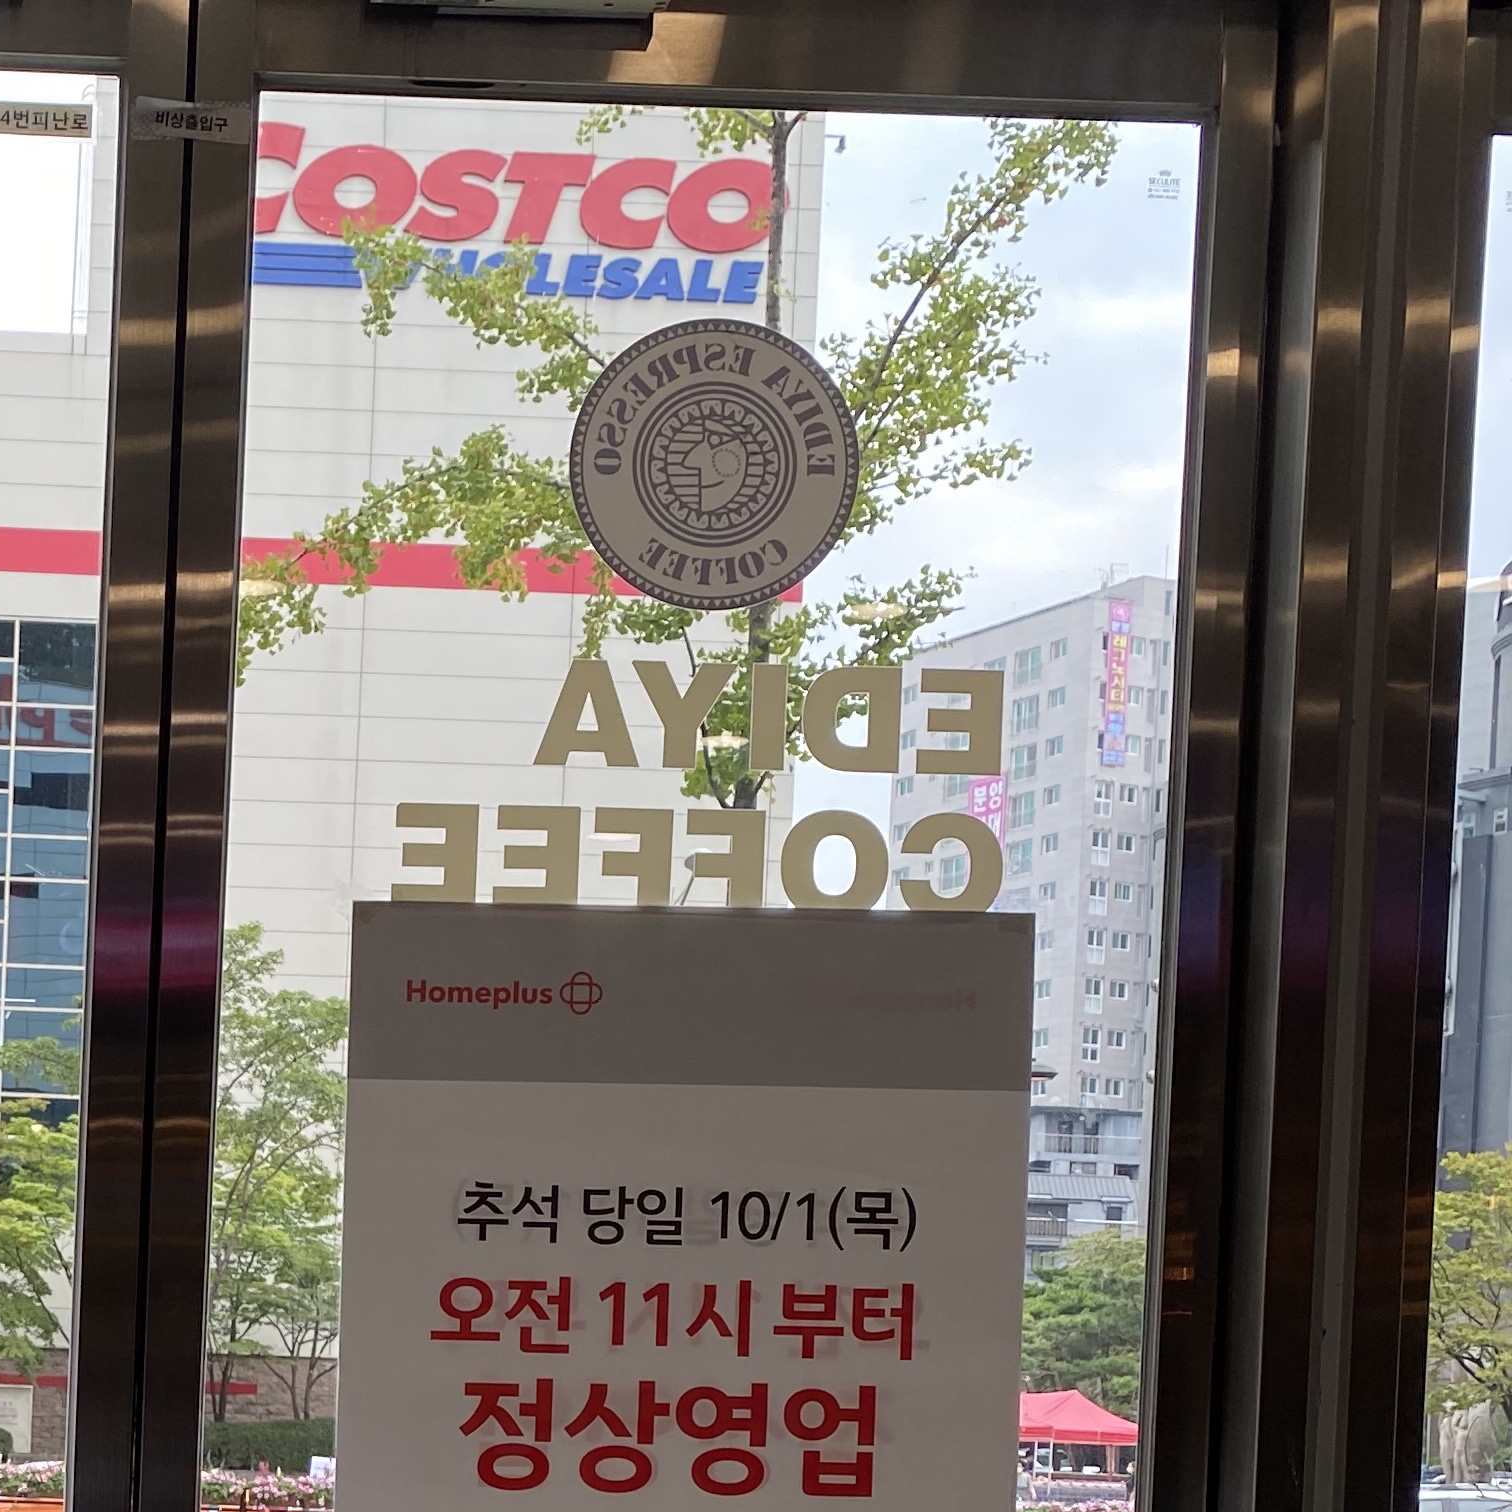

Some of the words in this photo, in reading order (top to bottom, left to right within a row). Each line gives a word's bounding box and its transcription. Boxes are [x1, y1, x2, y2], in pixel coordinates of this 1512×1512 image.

[0, 107, 88, 131] 4번피난로
[155, 110, 229, 133] 비상출입구
[973, 780, 1004, 813] 분양
[406, 978, 553, 1010] Homeplus
[456, 1180, 560, 1244] 추석
[581, 1185, 685, 1247] 당일
[710, 1185, 918, 1253] 10/1(목)
[430, 1275, 572, 1355] 오전
[458, 1377, 878, 1498] 정상영업
